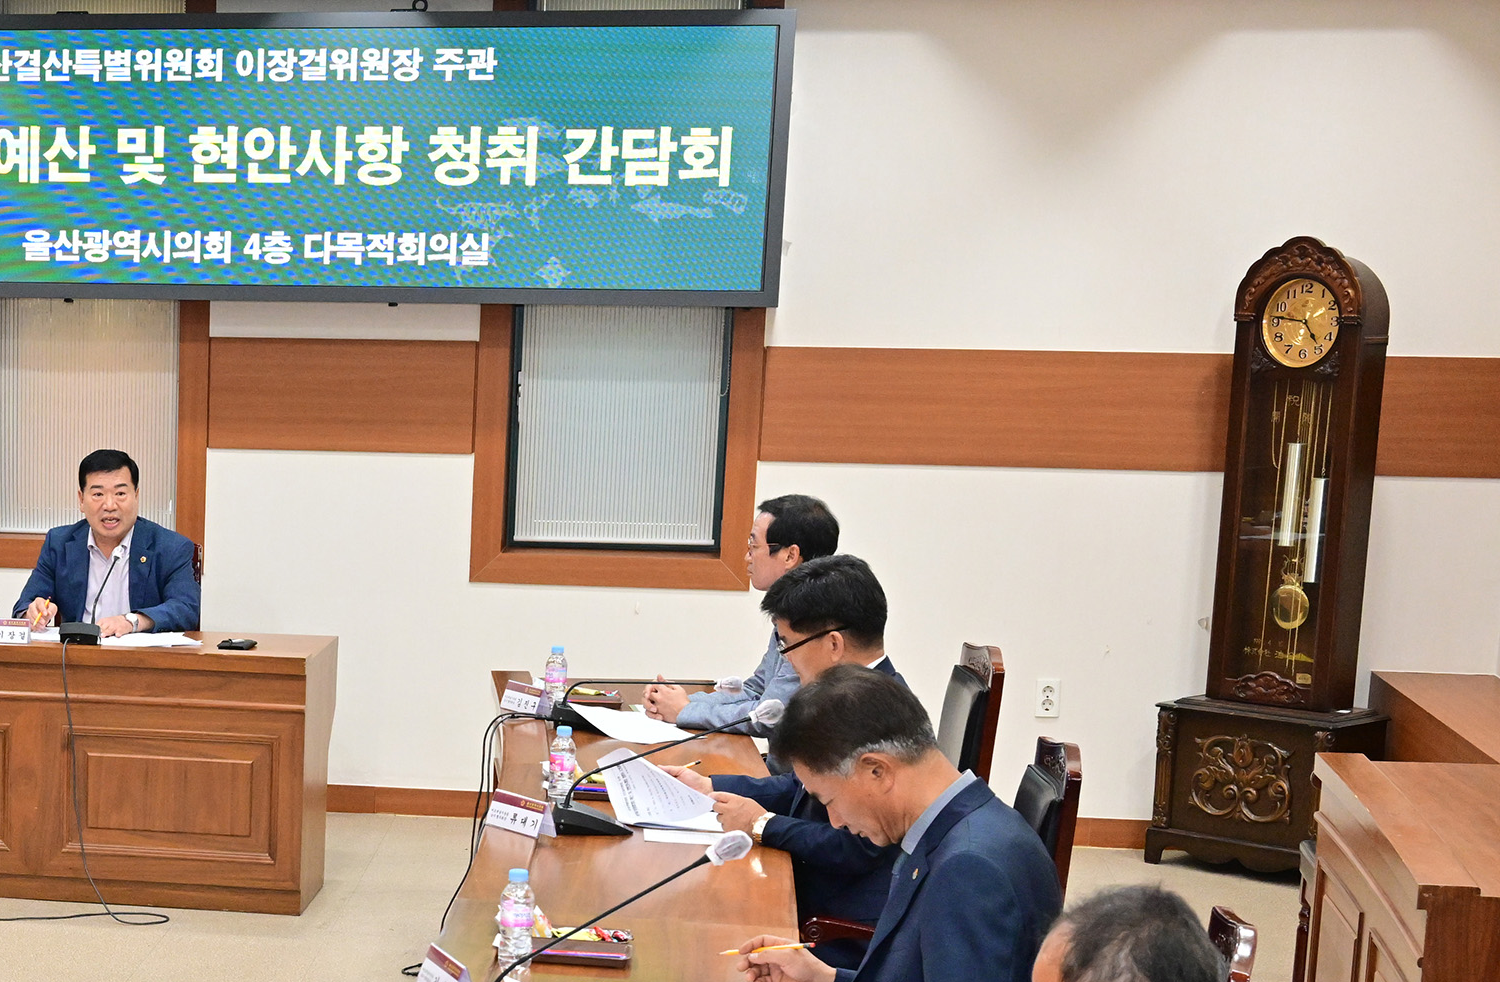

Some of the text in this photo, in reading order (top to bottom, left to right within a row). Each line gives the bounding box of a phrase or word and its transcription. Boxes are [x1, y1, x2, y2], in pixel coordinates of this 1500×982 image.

[235, 48, 424, 82] 이장걸위원장
[433, 47, 498, 82] 주관
[117, 126, 167, 185] 및
[189, 125, 407, 187] 현안사항
[428, 125, 540, 187] 청취
[563, 125, 734, 187] 간담회
[22, 229, 492, 268] 울산광역시의회 4층 다목적회의실
[1300, 282, 1314, 294] 12
[1321, 288, 1326, 299] 1
[1286, 288, 1297, 300] 11
[1276, 301, 1287, 312] 10
[1328, 300, 1337, 311] 2
[1271, 317, 1280, 327] 9
[1330, 316, 1340, 327] 3
[1273, 332, 1283, 343] 8
[1323, 331, 1333, 342] 4
[1284, 343, 1293, 354] 7
[1298, 348, 1308, 360] 6
[1313, 343, 1323, 355] 5
